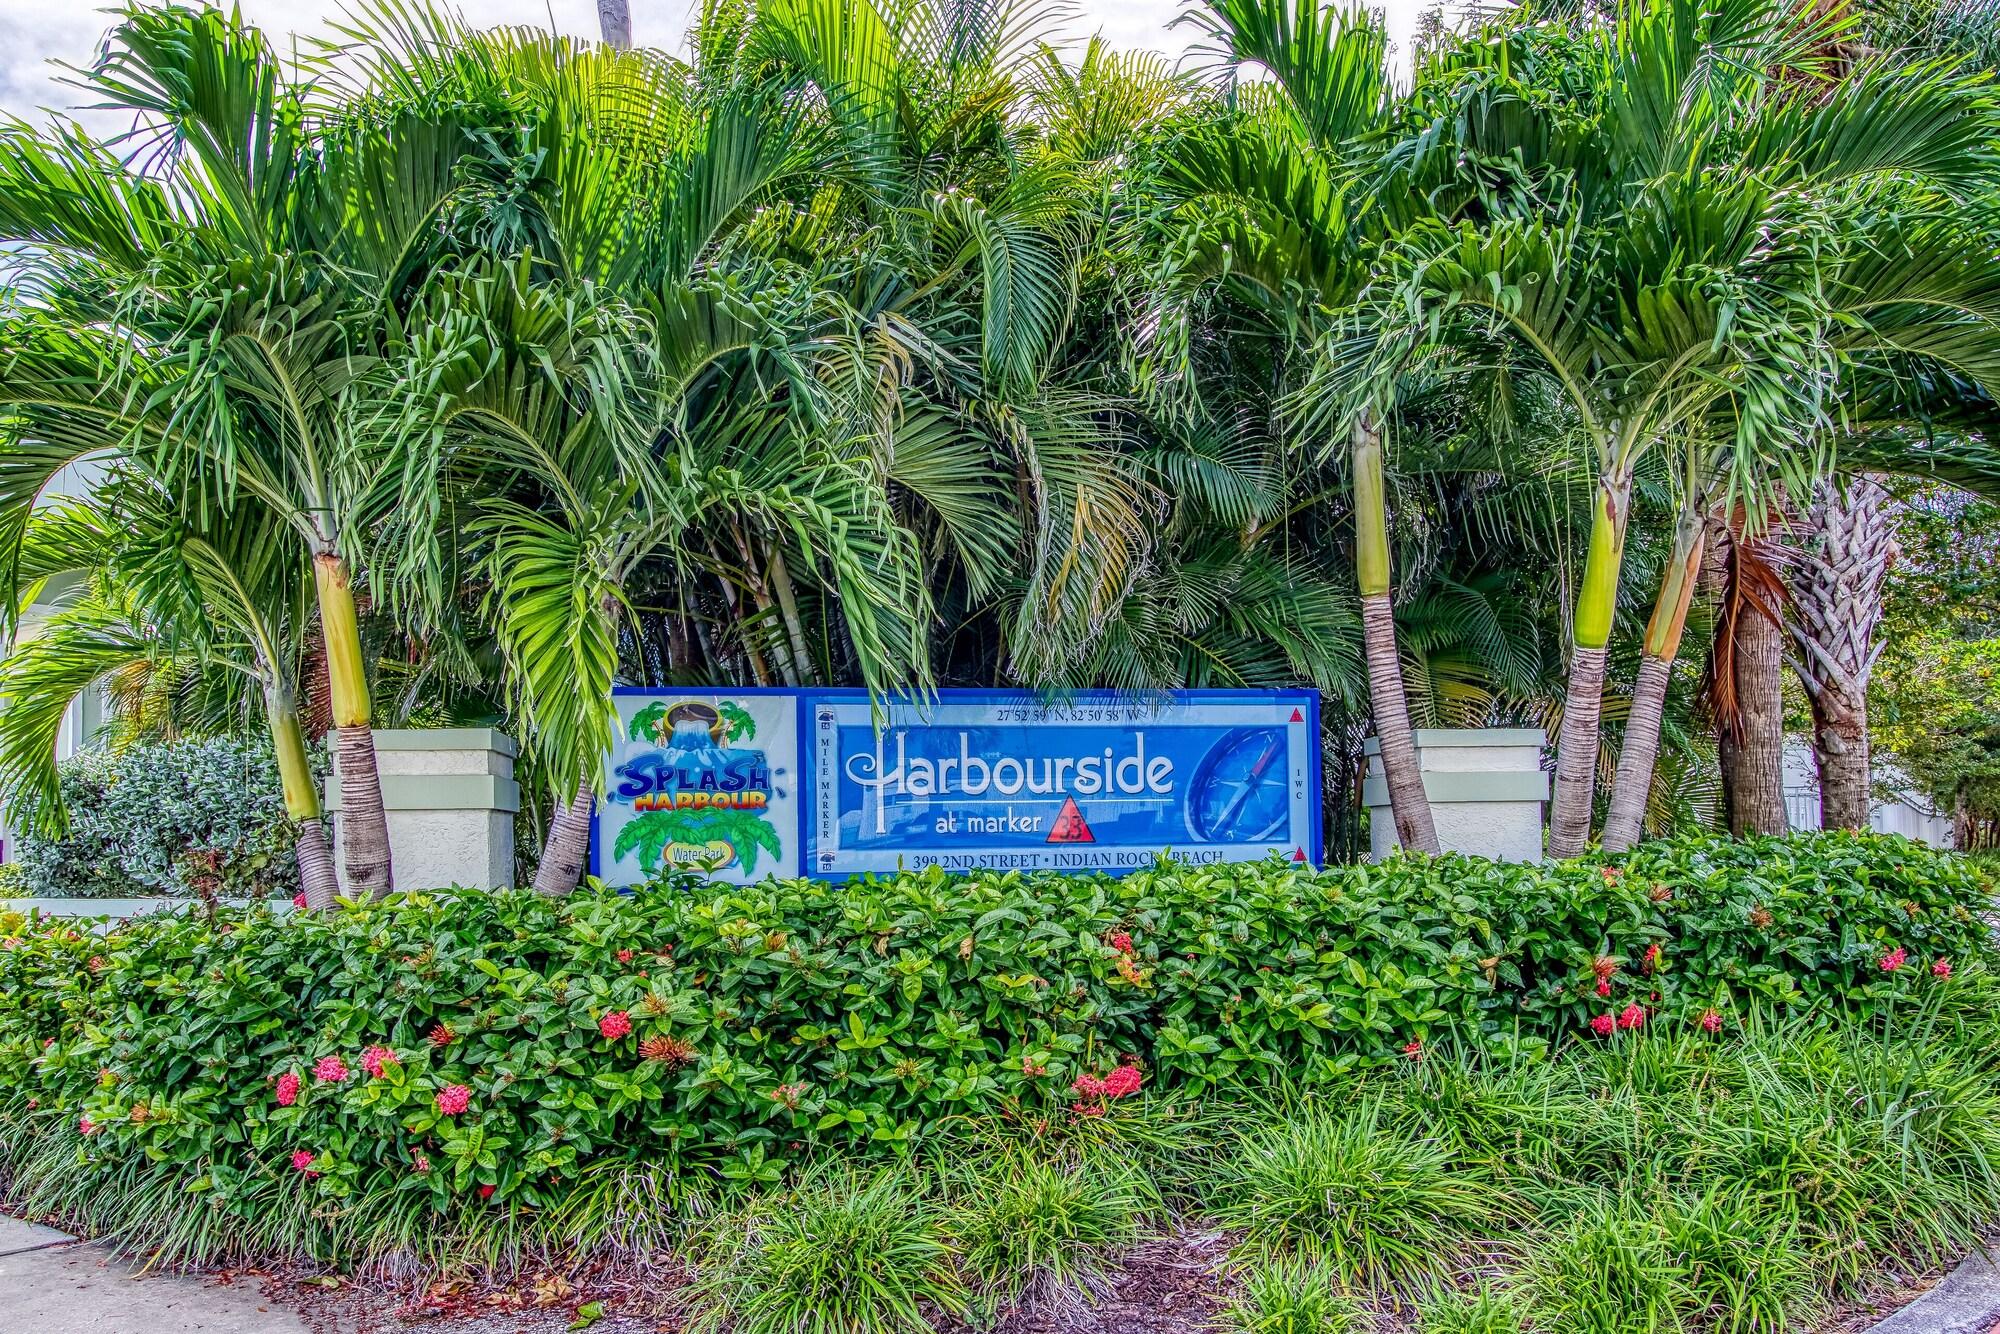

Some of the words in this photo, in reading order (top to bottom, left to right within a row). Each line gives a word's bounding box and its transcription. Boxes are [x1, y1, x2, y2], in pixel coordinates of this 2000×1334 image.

[1126, 709, 1140, 721] W
[821, 739, 829, 776] MILE
[617, 752, 771, 797] SPLASH
[845, 731, 1174, 834] Harbourside
[634, 791, 768, 812] HARBOUR
[821, 782, 830, 838] MARKER
[935, 811, 958, 833] at
[968, 806, 1042, 833] marker
[1059, 815, 1082, 839] 33
[672, 847, 702, 861] Water
[913, 855, 938, 869] 399
[942, 855, 975, 868] 2ND
[979, 854, 1040, 867] STREET
[1053, 852, 1111, 867] INDIAN
[1172, 850, 1224, 865] BEACH
